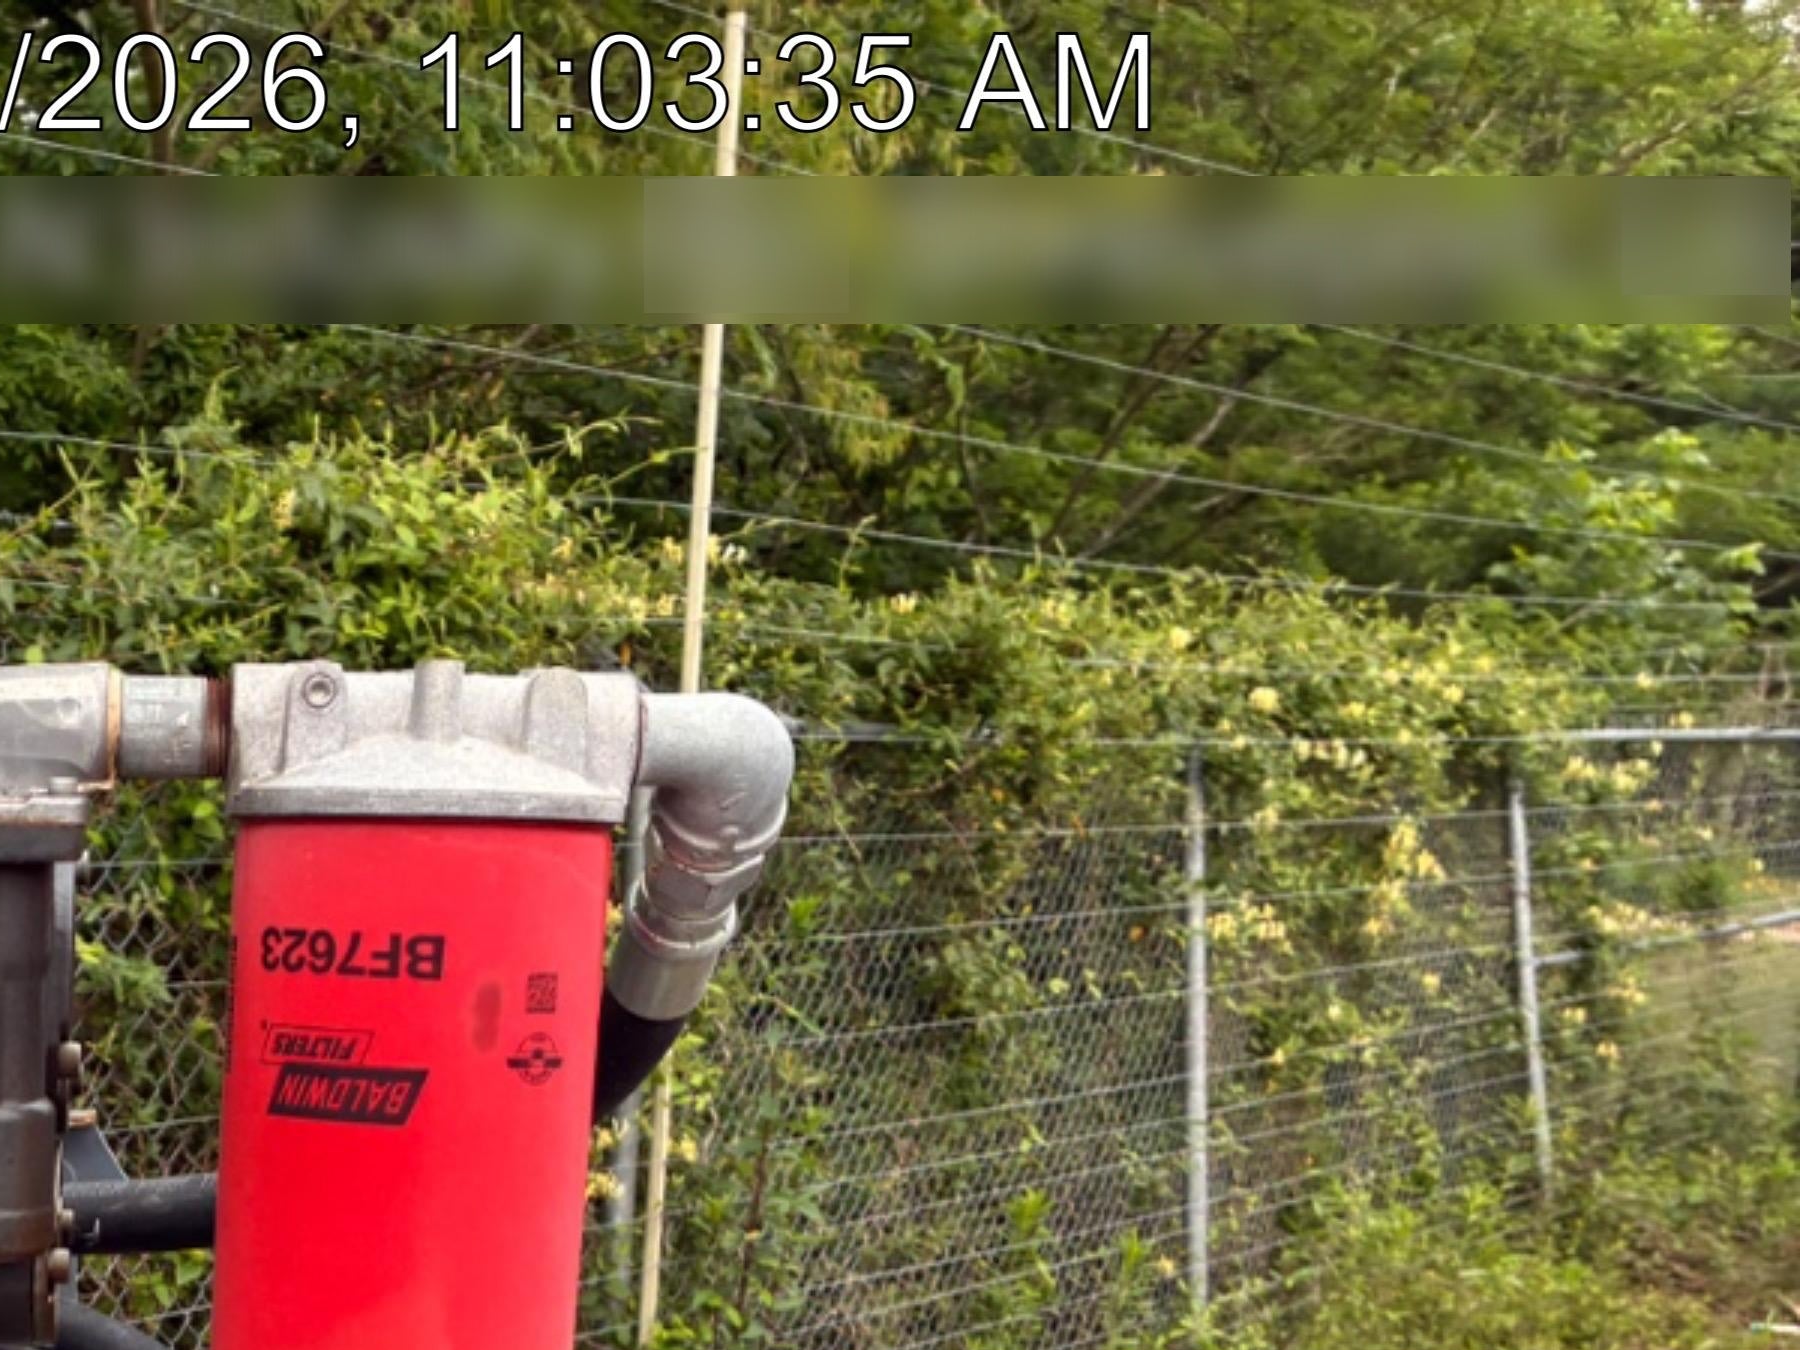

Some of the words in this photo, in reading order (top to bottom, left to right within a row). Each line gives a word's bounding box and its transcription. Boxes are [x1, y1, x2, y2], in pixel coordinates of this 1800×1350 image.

[260, 926, 446, 981] BF7623
[272, 1032, 358, 1060] FILTERS
[279, 1073, 412, 1113] BALDWIN
